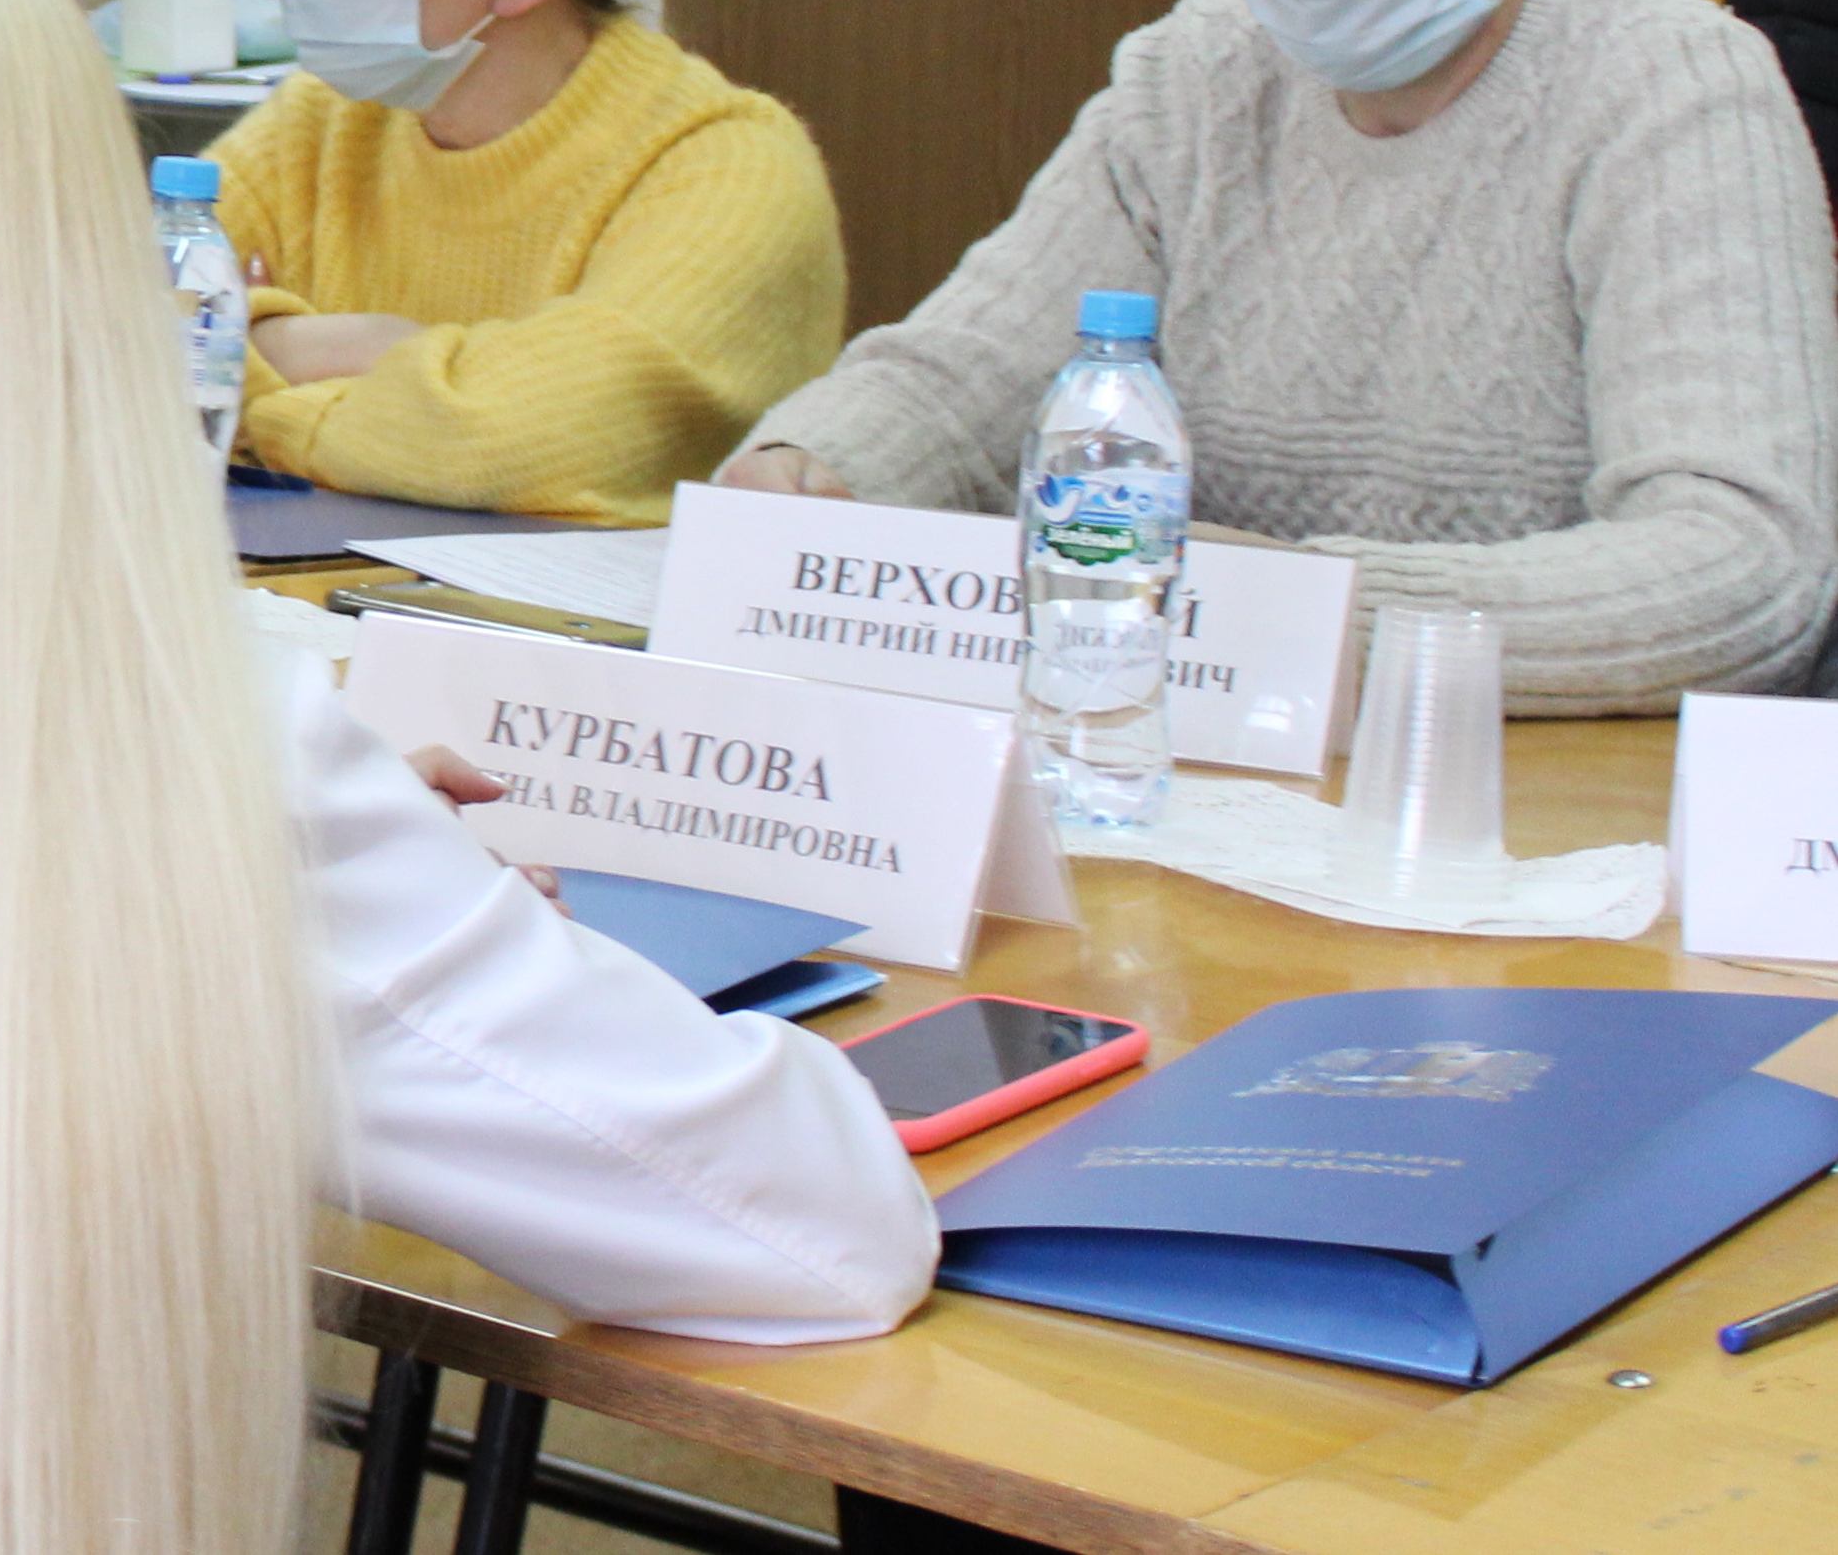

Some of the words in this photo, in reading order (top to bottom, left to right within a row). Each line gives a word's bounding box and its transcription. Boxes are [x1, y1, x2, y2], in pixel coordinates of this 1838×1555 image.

[736, 605, 939, 656] ДМИТРИЙ
[485, 698, 832, 802] КУРБАТОВА
[568, 783, 903, 874] ВЛАДИМИРОВНА
